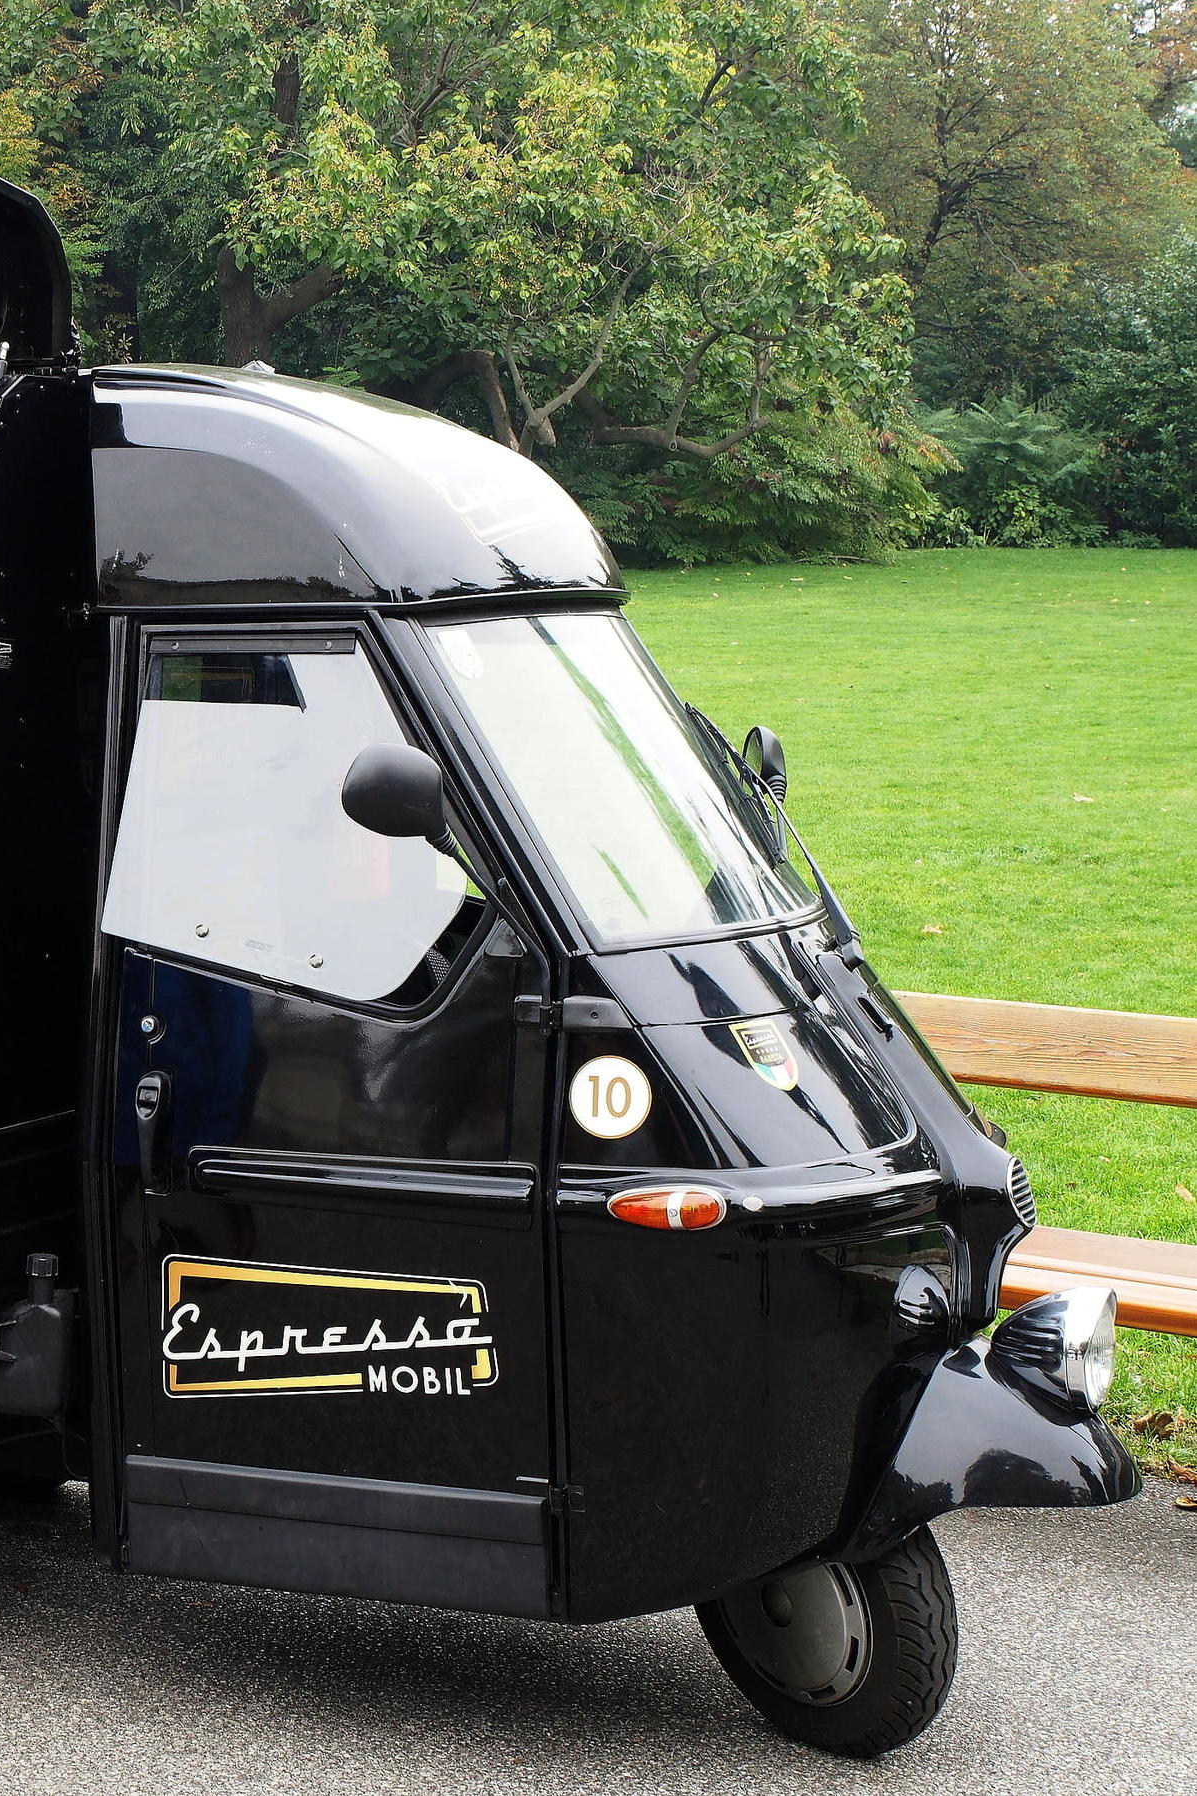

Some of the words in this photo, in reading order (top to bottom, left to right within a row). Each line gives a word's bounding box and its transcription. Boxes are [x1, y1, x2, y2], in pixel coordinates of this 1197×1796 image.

[588, 1075, 632, 1118] 10
[162, 1302, 493, 1372] Espresso
[368, 1366, 471, 1395] MOBIL
